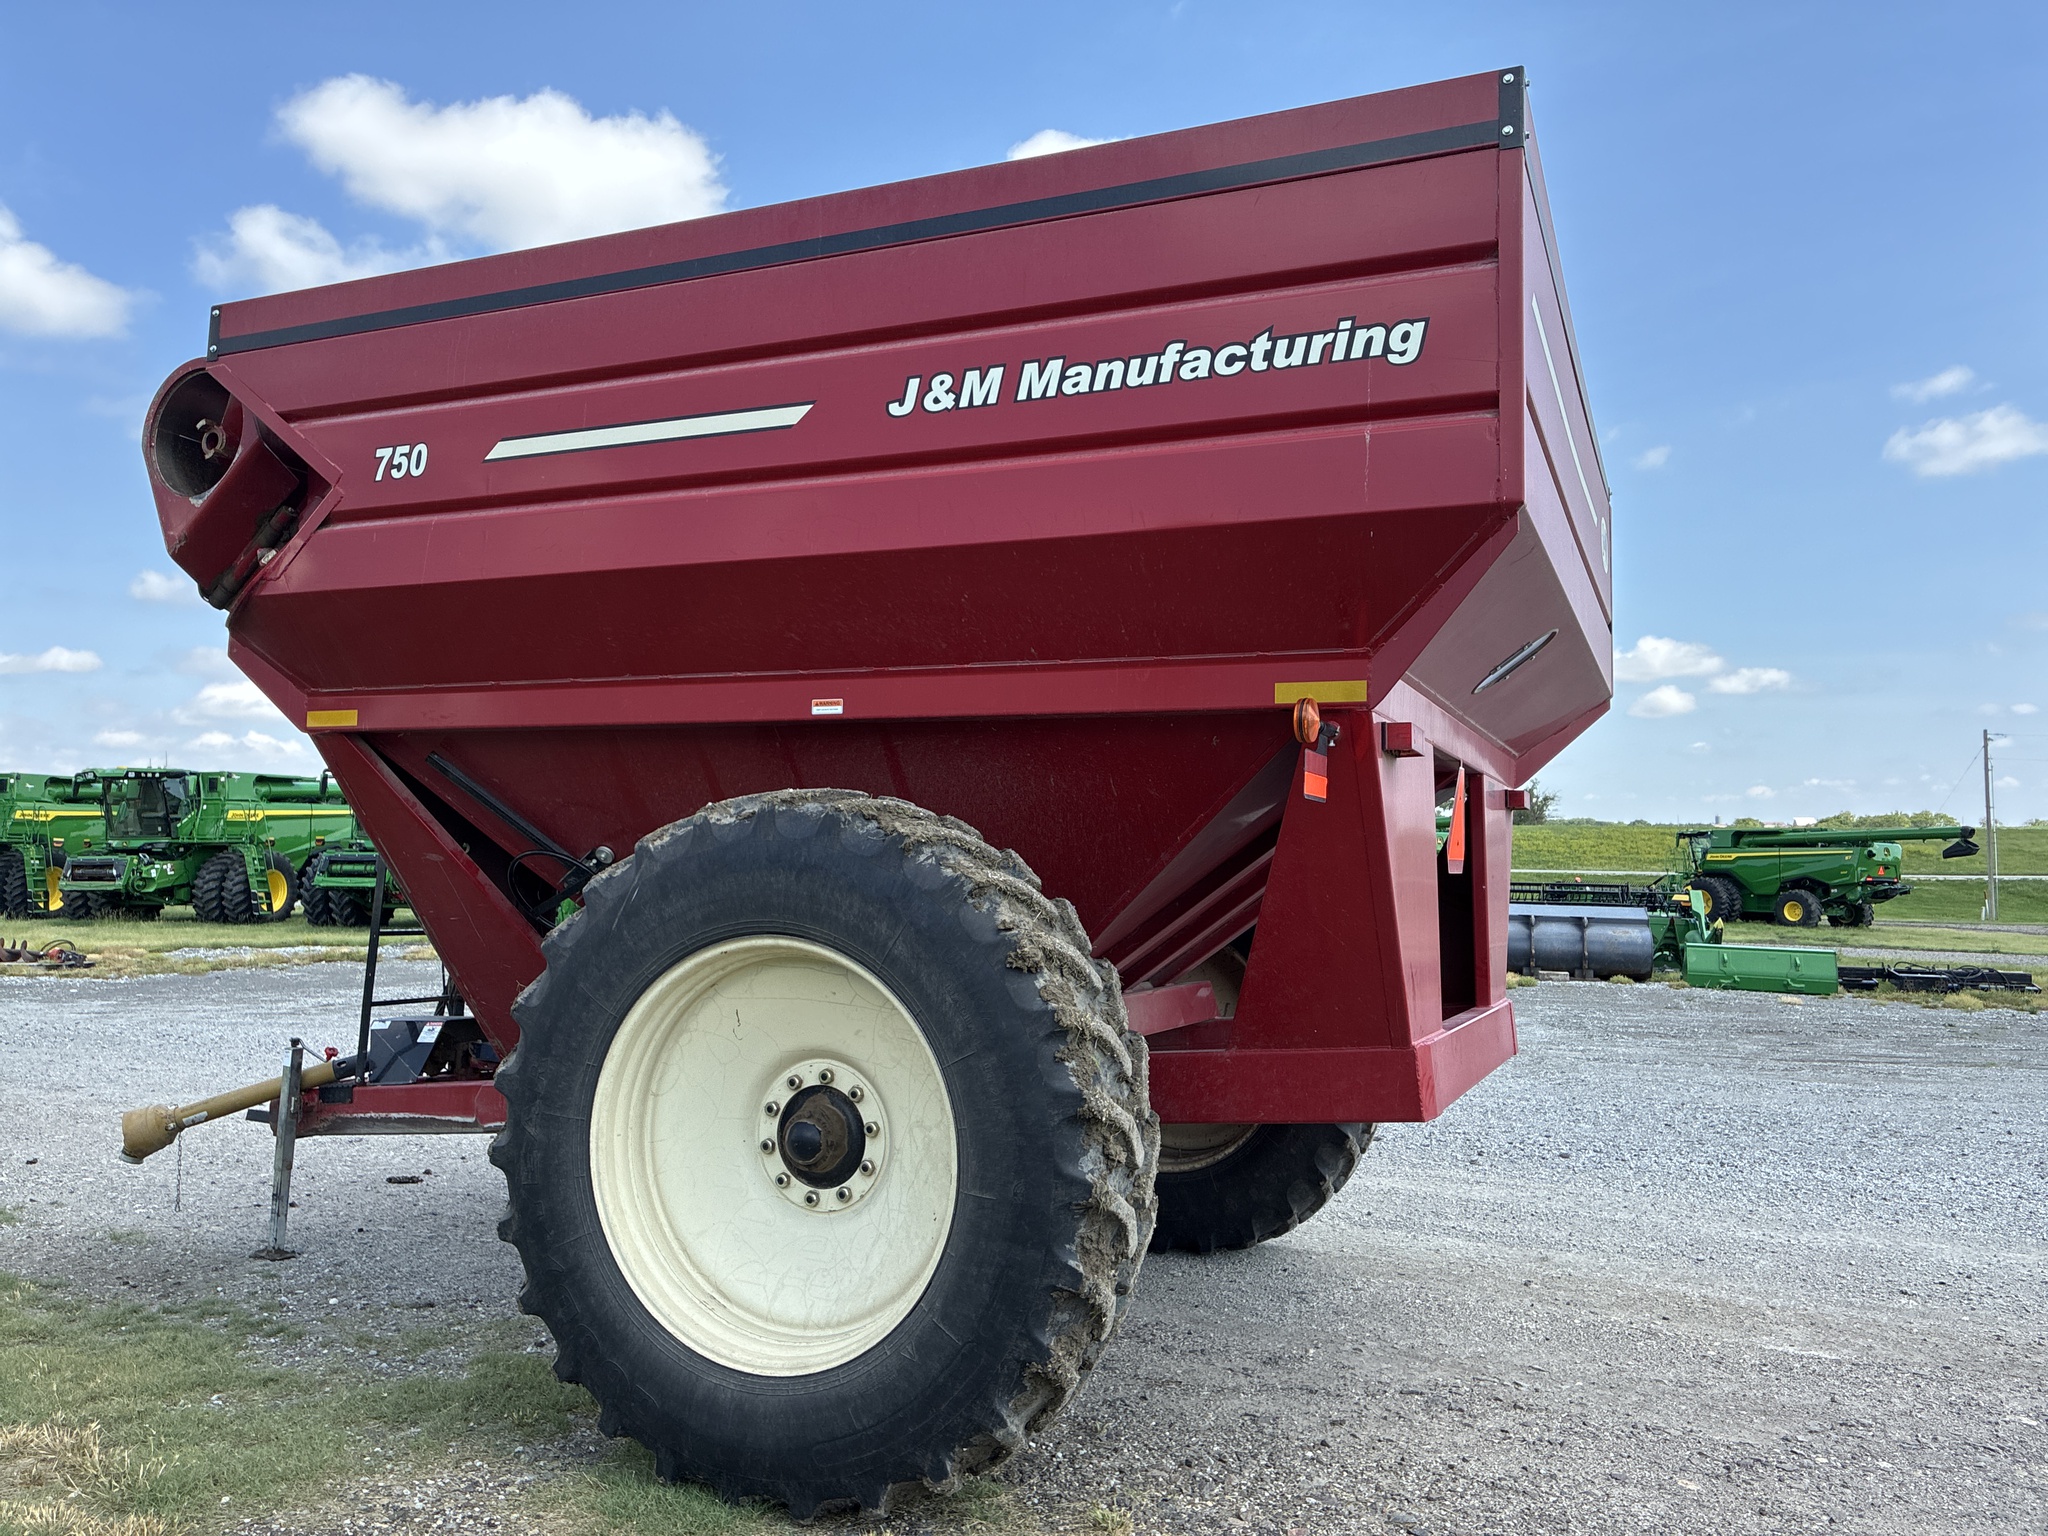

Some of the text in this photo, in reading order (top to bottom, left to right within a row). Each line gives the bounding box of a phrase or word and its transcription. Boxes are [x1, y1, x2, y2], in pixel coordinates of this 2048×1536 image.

[887, 316, 1430, 418] J&M Manufacturing
[375, 442, 428, 482] 750
